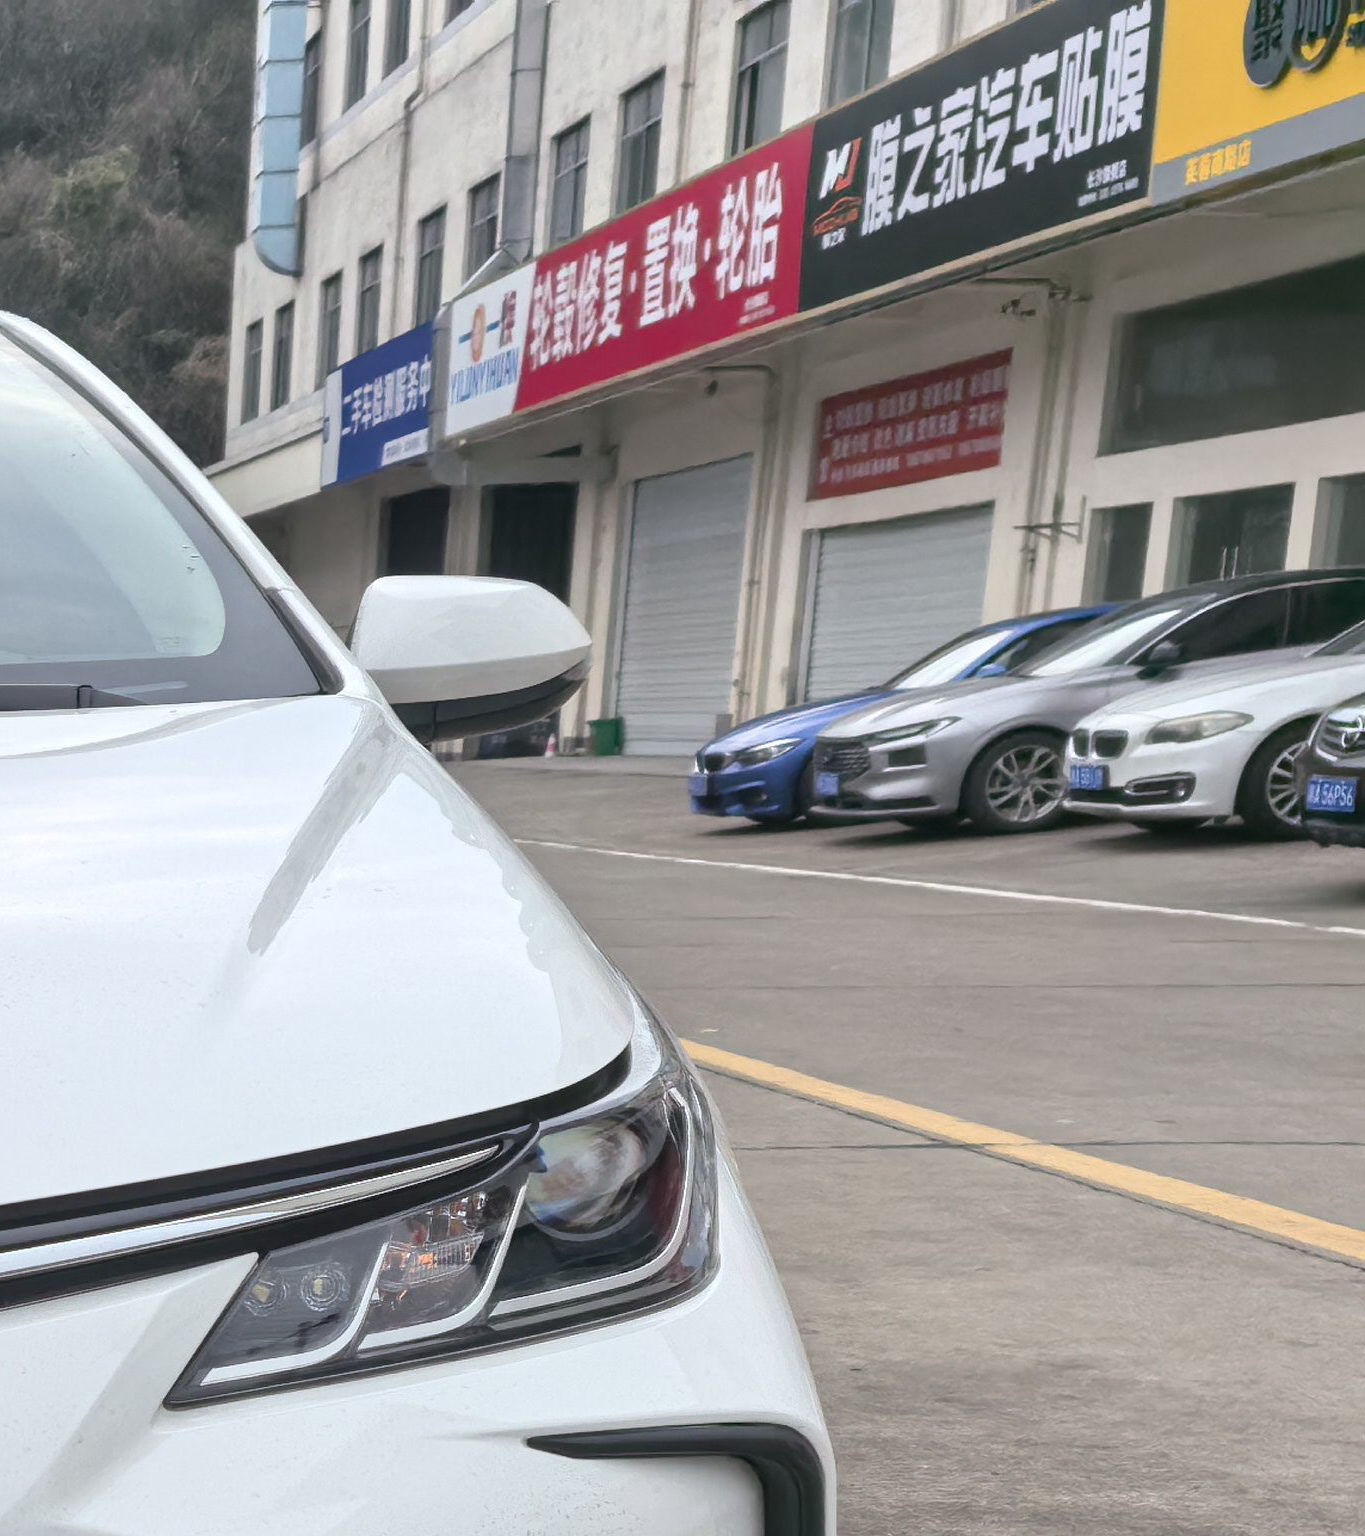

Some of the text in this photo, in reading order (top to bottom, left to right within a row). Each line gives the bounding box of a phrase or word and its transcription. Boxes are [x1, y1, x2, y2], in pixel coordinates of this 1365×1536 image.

[861, 0, 1152, 237] 膜之家汽车贴膜
